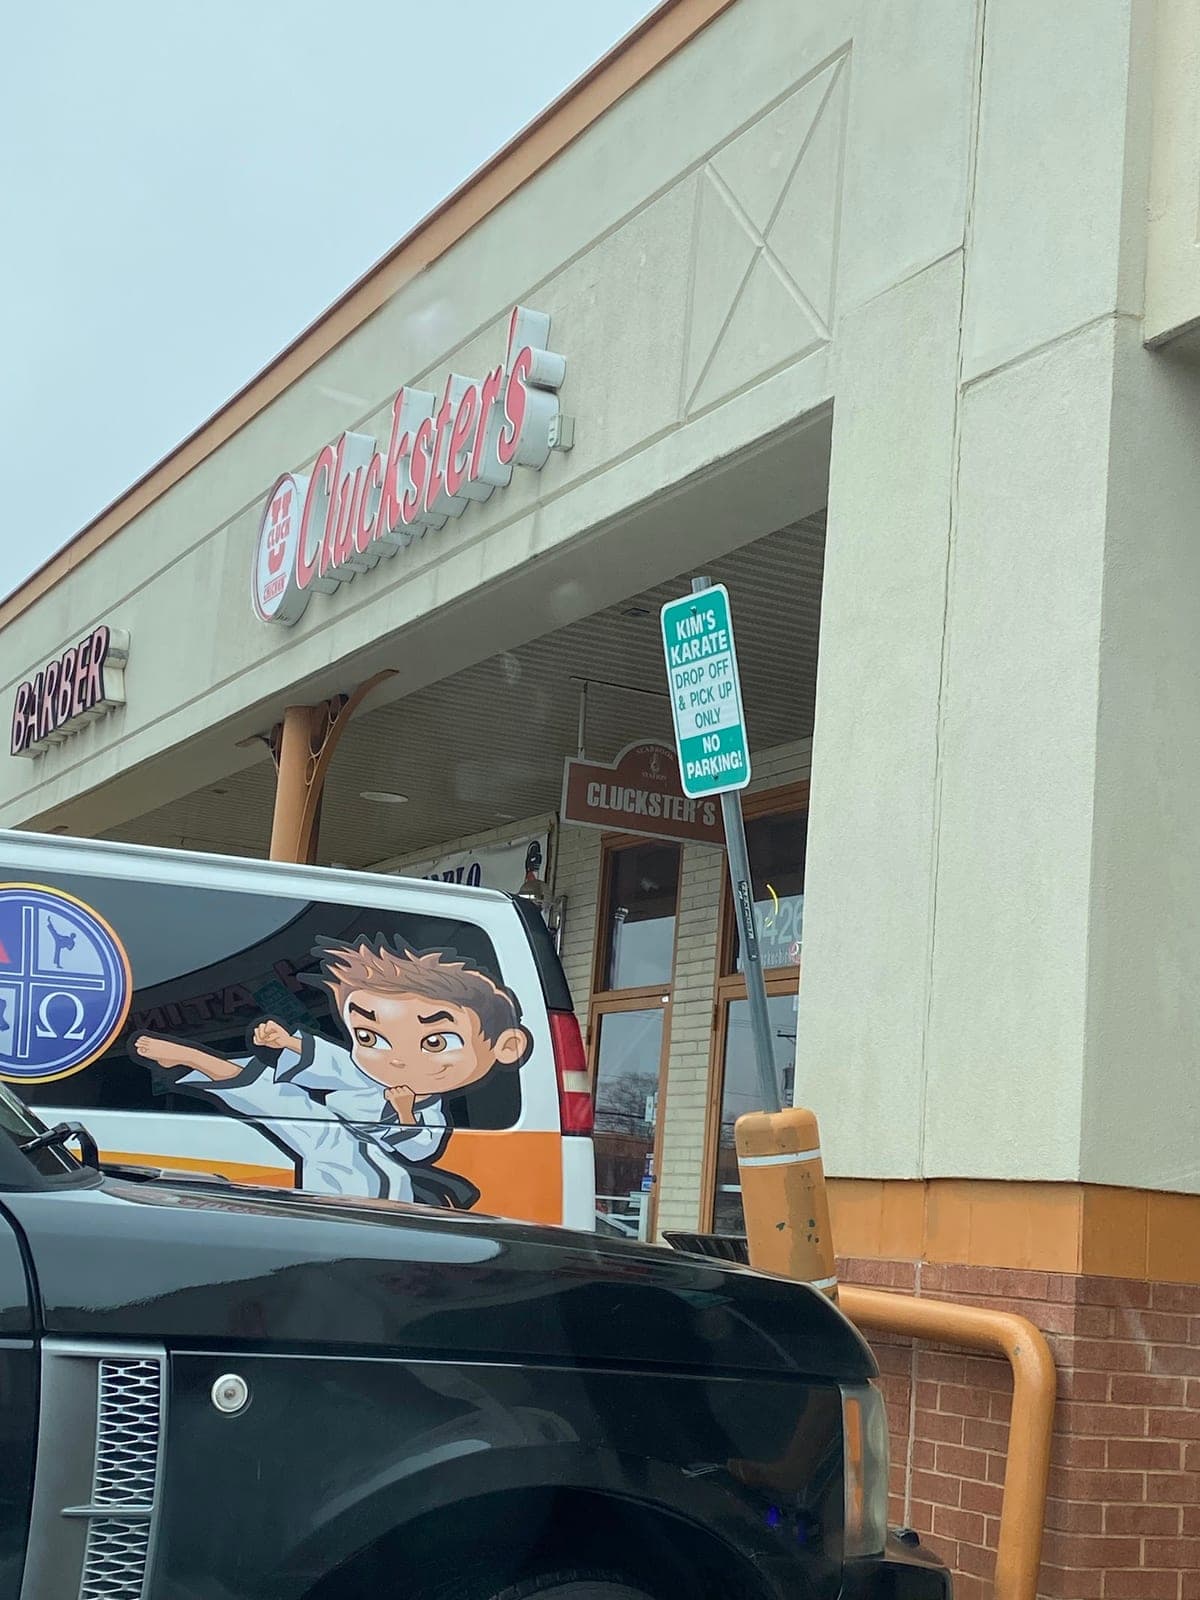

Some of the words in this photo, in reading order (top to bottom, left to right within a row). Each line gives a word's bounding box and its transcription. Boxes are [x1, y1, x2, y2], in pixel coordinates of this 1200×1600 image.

[296, 305, 533, 590] Cluckster's
[676, 609, 716, 641] KIM'S
[671, 629, 728, 666] KARATE
[675, 667, 705, 690] DROP
[708, 658, 729, 679] OFF
[11, 625, 110, 756] BARBER
[678, 695, 686, 711] &
[690, 686, 715, 707] PICK
[718, 681, 732, 699] UP
[695, 707, 721, 729] ONLY
[702, 734, 721, 754] NO
[686, 750, 743, 779] PARKING!
[587, 782, 716, 826] CLUCKSTER'S
